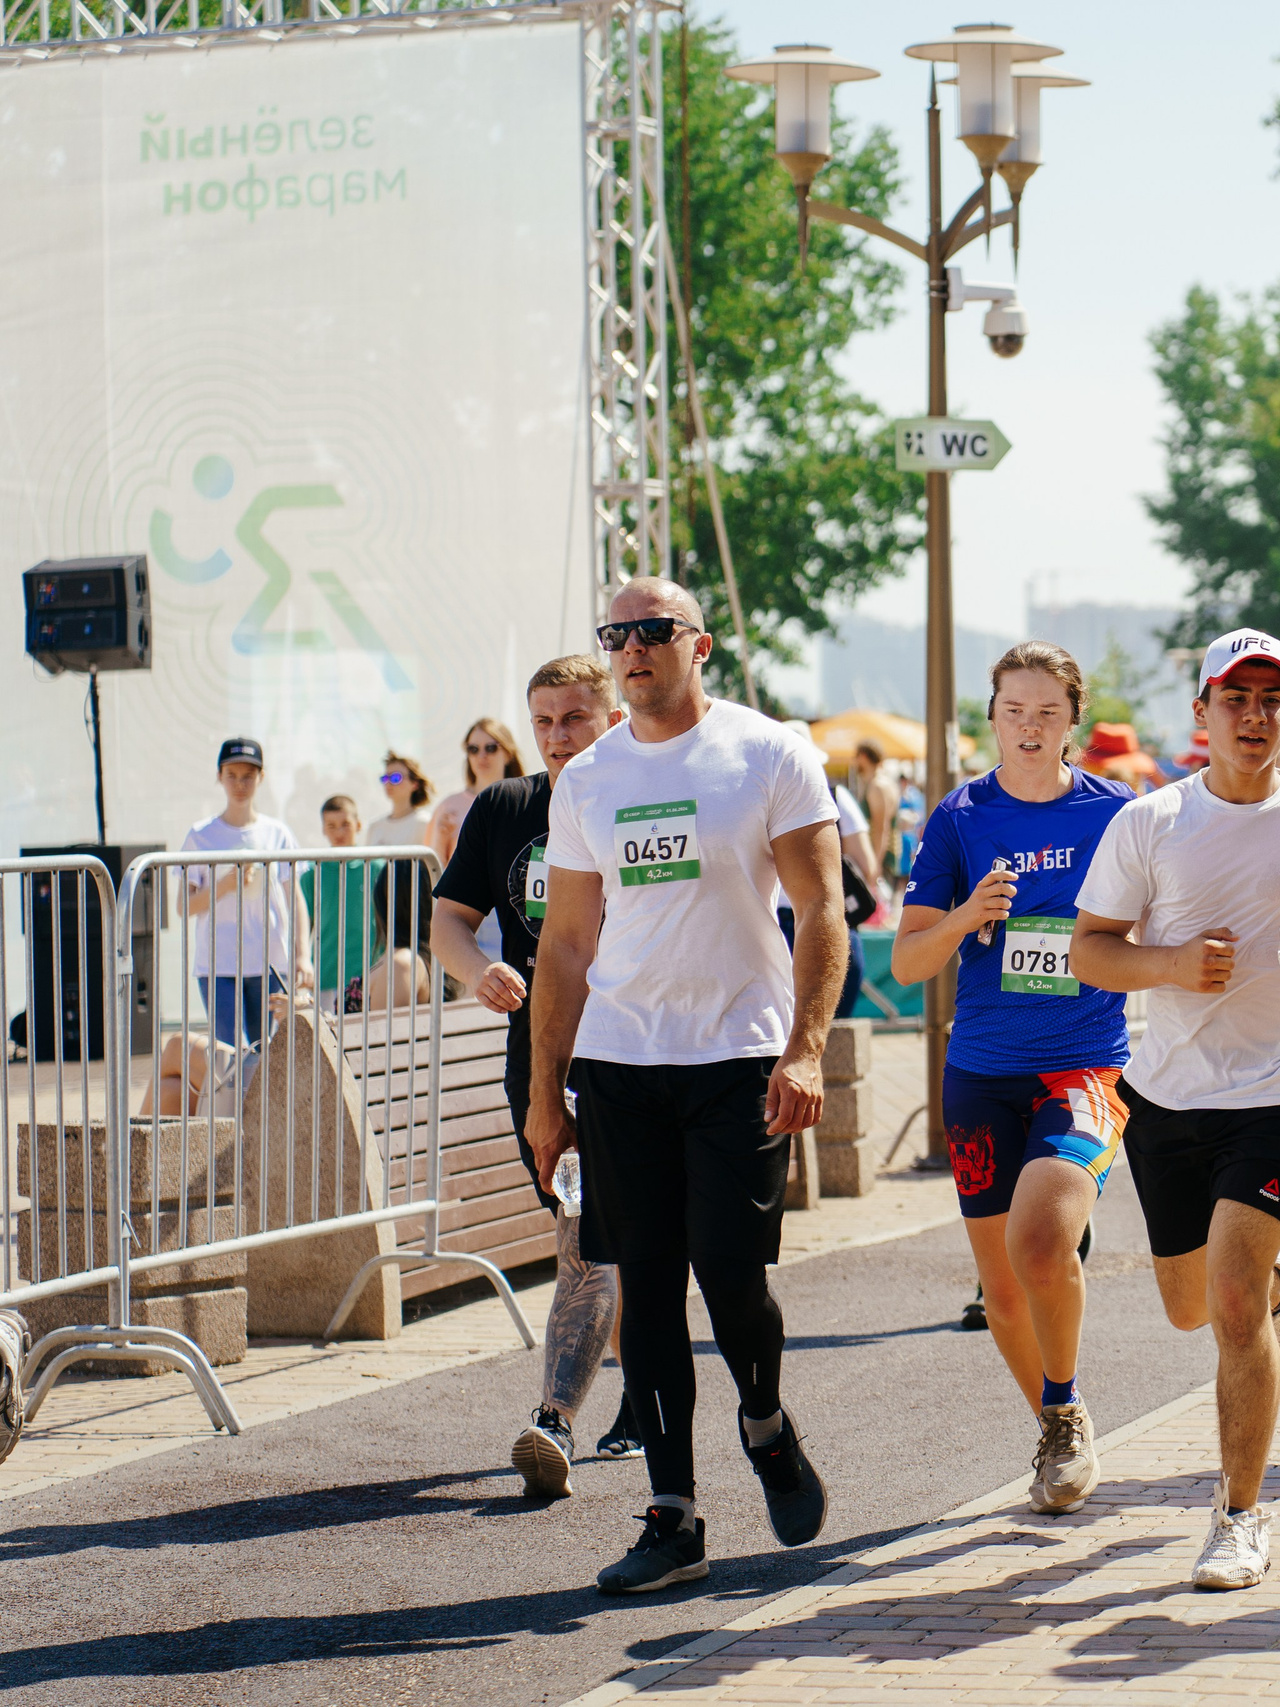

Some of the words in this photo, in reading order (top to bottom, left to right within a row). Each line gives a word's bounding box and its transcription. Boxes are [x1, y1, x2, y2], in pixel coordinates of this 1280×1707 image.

[942, 434, 988, 457] WC
[1231, 637, 1271, 653] UFC
[624, 834, 688, 864] 0457
[1011, 949, 1069, 975] 0781
